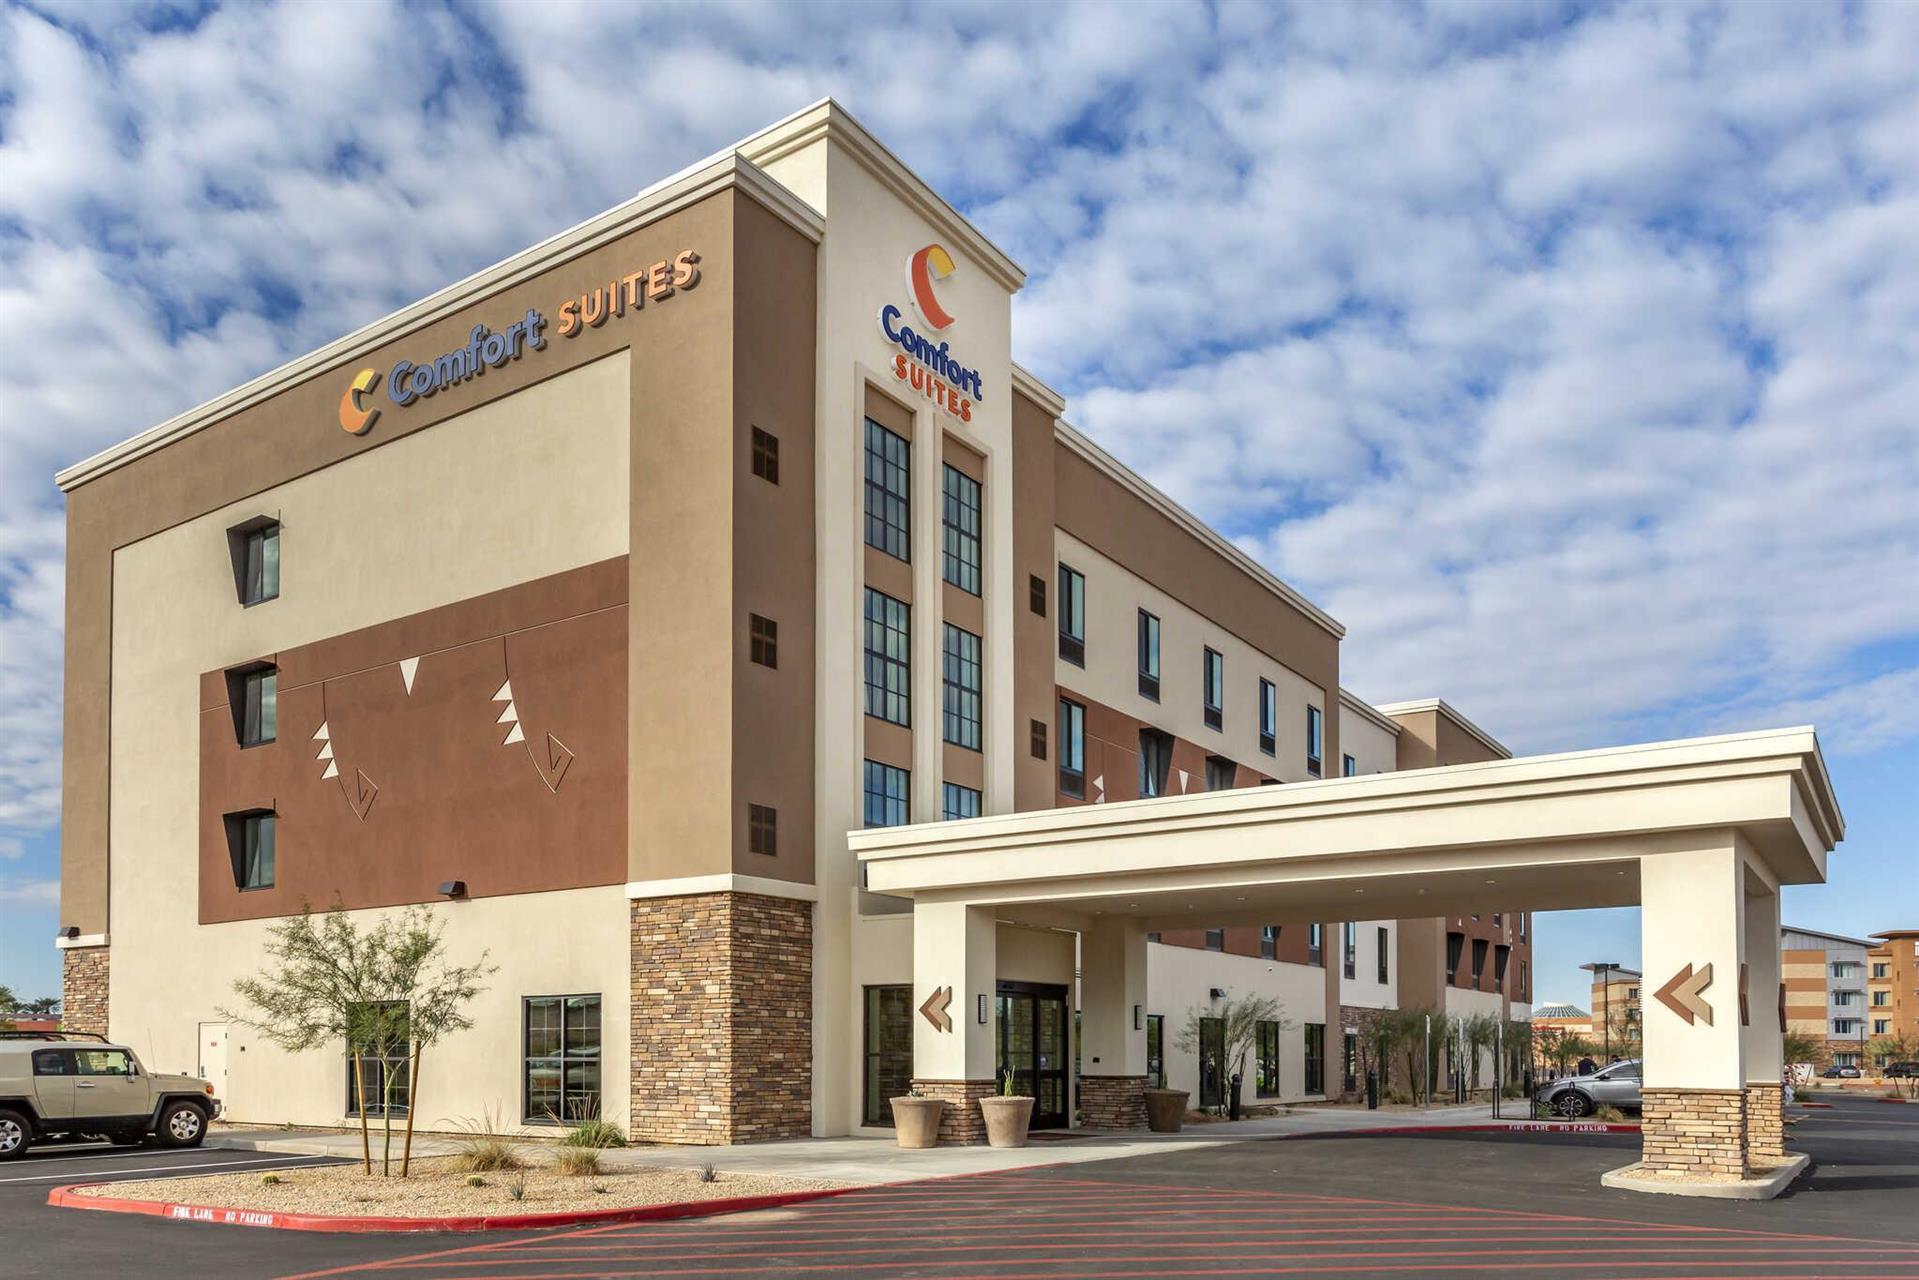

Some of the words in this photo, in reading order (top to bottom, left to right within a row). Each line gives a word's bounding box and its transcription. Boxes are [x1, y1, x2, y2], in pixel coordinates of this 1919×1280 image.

[387, 308, 545, 406] Comfort
[556, 249, 701, 337] SUITES
[879, 304, 983, 401] Comfort
[894, 354, 972, 422] SUITES
[1573, 1124, 1608, 1132] PARKING
[173, 1206, 190, 1218] FIRE
[194, 1208, 214, 1220] LANE
[225, 1211, 236, 1222] NO
[240, 1212, 273, 1225] PARKING
